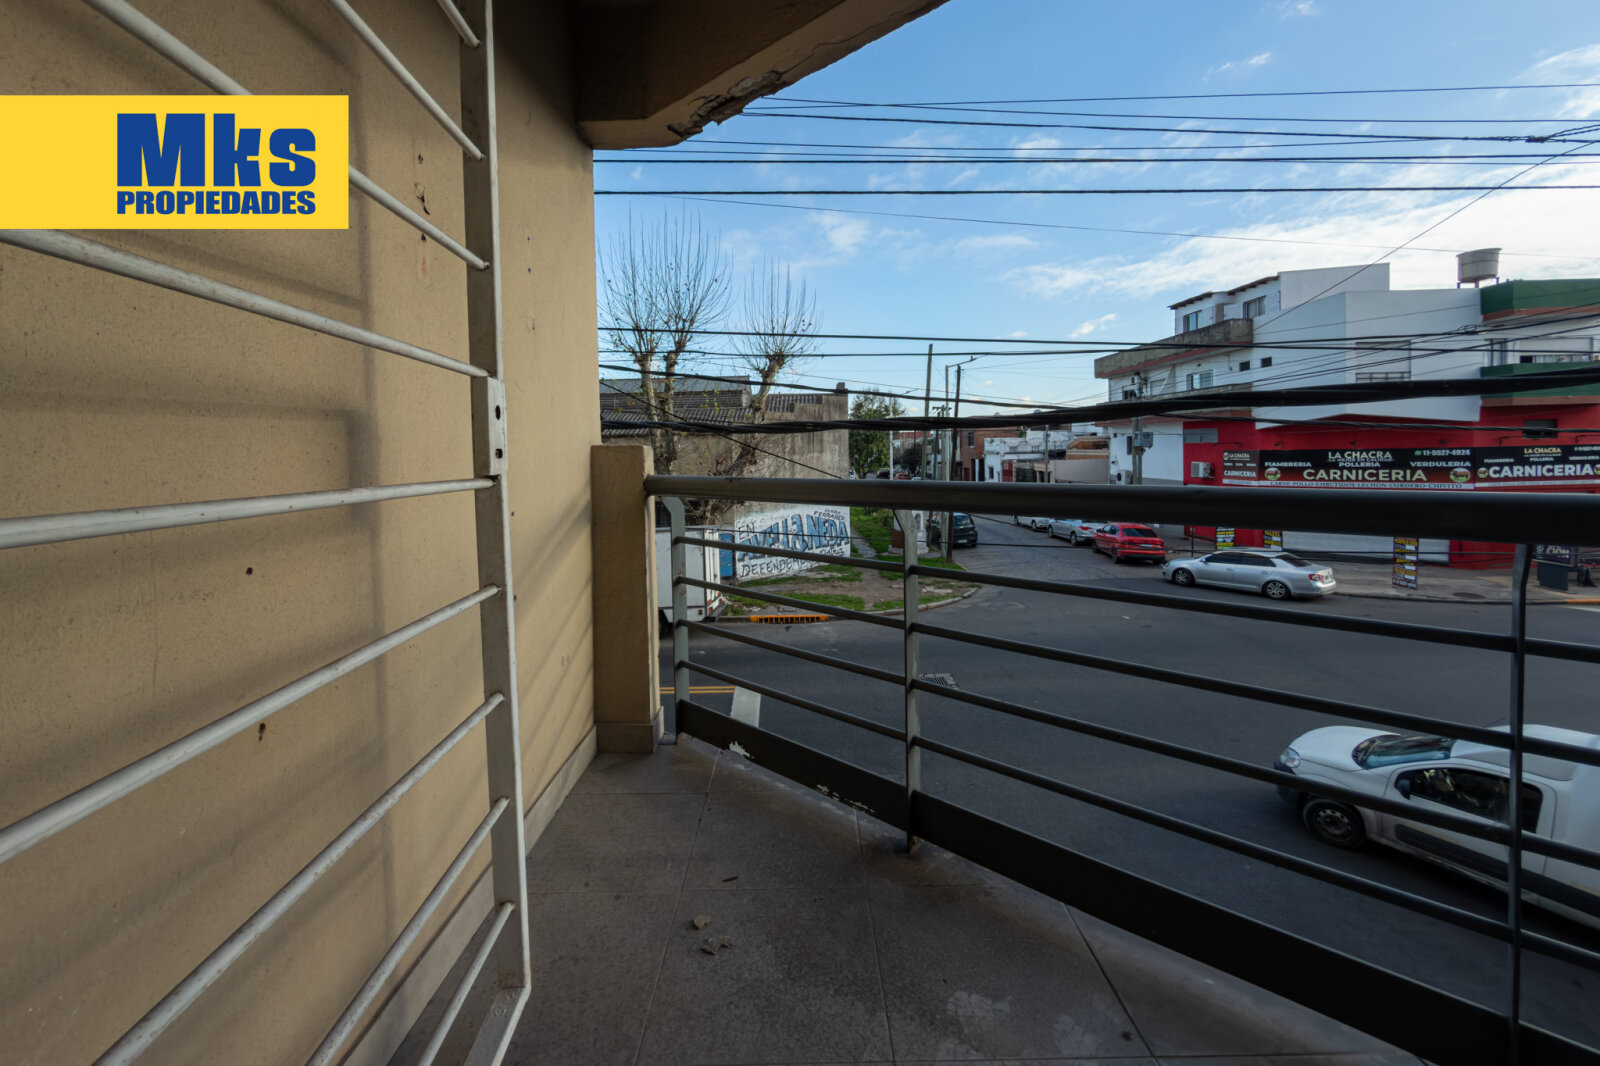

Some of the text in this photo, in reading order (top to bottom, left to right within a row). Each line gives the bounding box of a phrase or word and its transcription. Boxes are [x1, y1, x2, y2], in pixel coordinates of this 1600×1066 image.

[1328, 451, 1393, 460] LA CHACRA
[1303, 469, 1428, 481] CARNICERIA
[1489, 464, 1594, 478] CARNICERIA
[738, 521, 755, 541] EN
